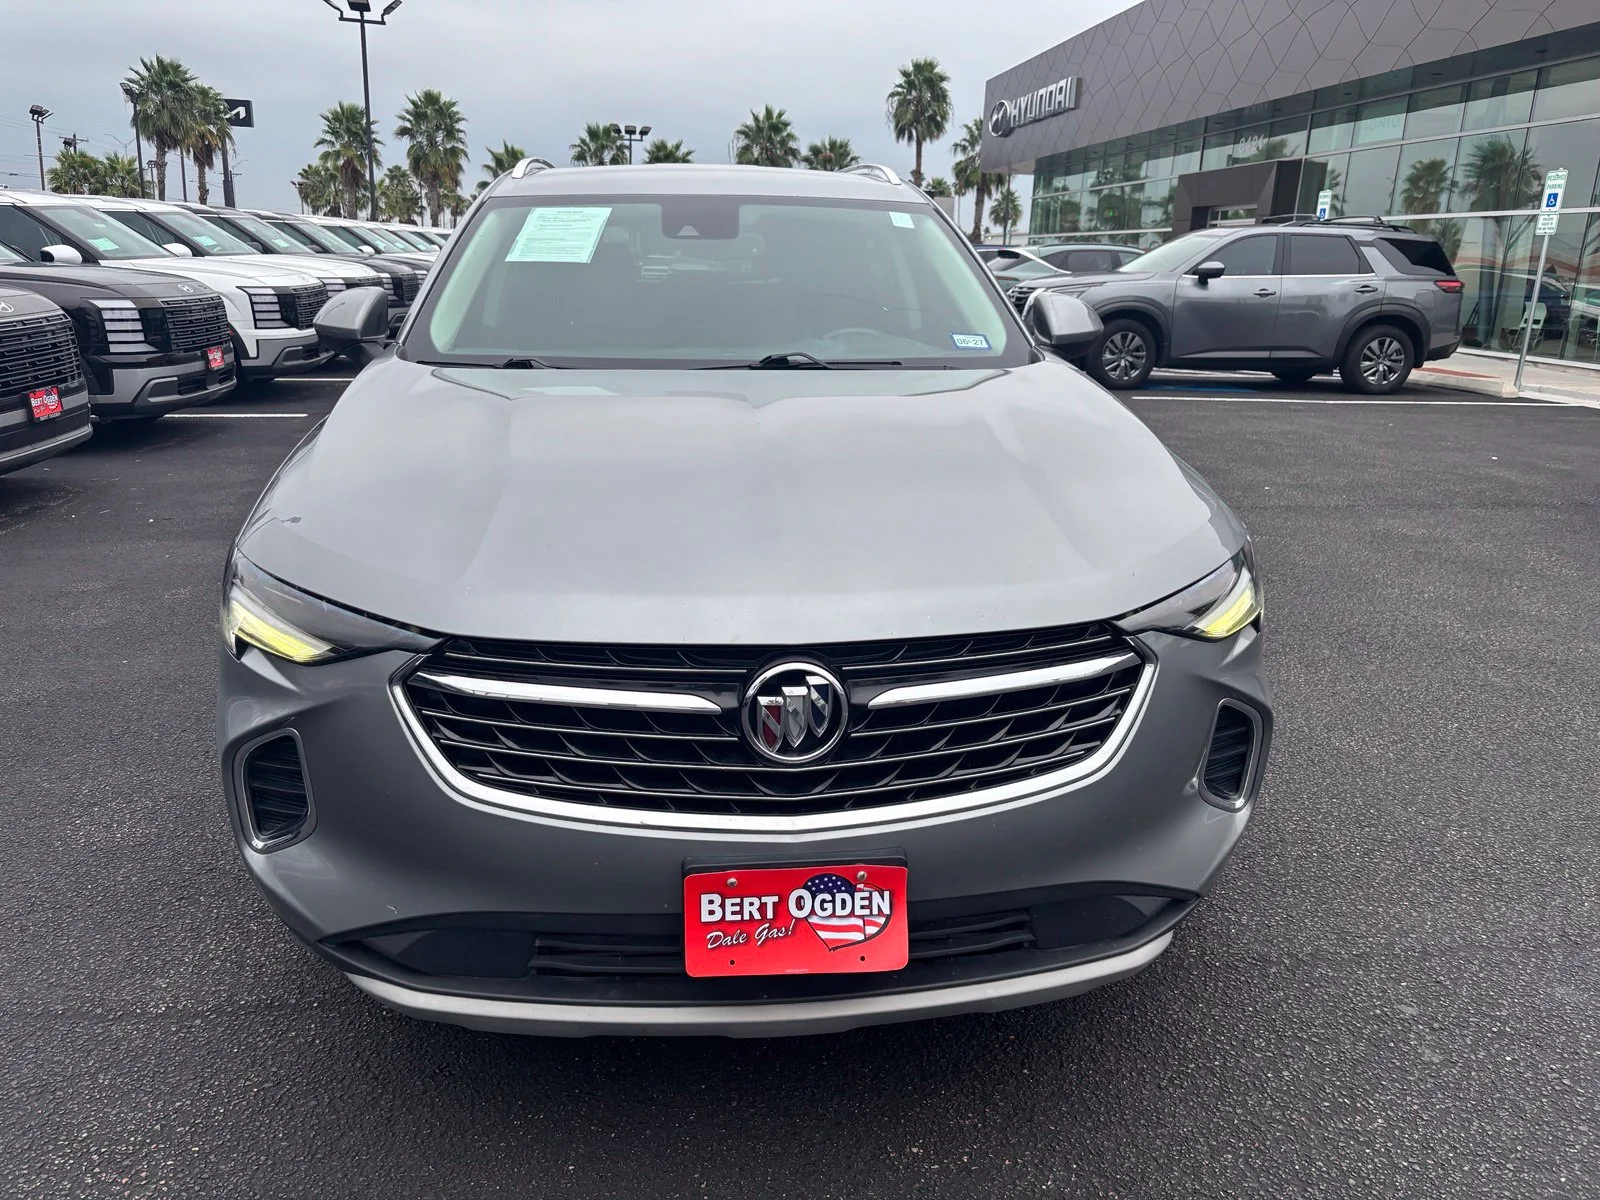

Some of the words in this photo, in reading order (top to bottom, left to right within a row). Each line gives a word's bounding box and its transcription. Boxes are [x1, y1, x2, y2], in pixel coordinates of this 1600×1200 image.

[1010, 76, 1077, 128] HYUNDAI
[700, 893, 779, 923] BERT
[787, 888, 891, 919] OGDEN
[706, 930, 747, 949] Dale
[754, 919, 796, 946] Gas!
